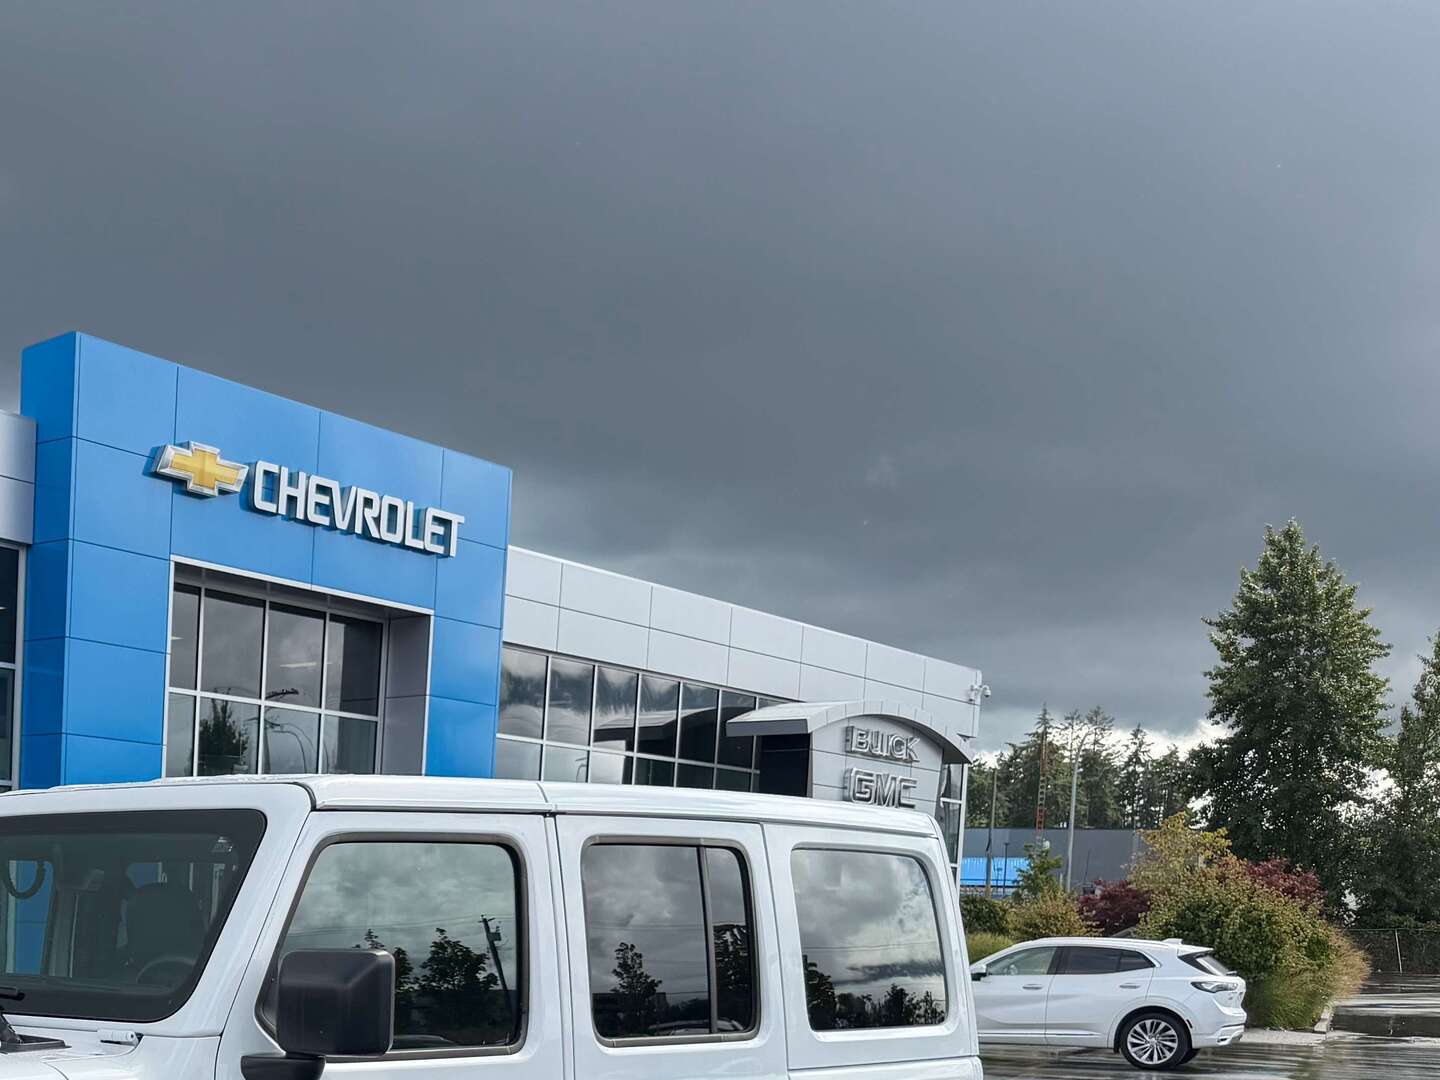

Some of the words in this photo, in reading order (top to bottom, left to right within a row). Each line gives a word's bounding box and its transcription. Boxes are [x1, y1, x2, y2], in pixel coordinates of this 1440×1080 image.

[253, 460, 465, 558] CHEVROLET
[847, 726, 921, 762] BUICK
[846, 767, 918, 809] GMC
